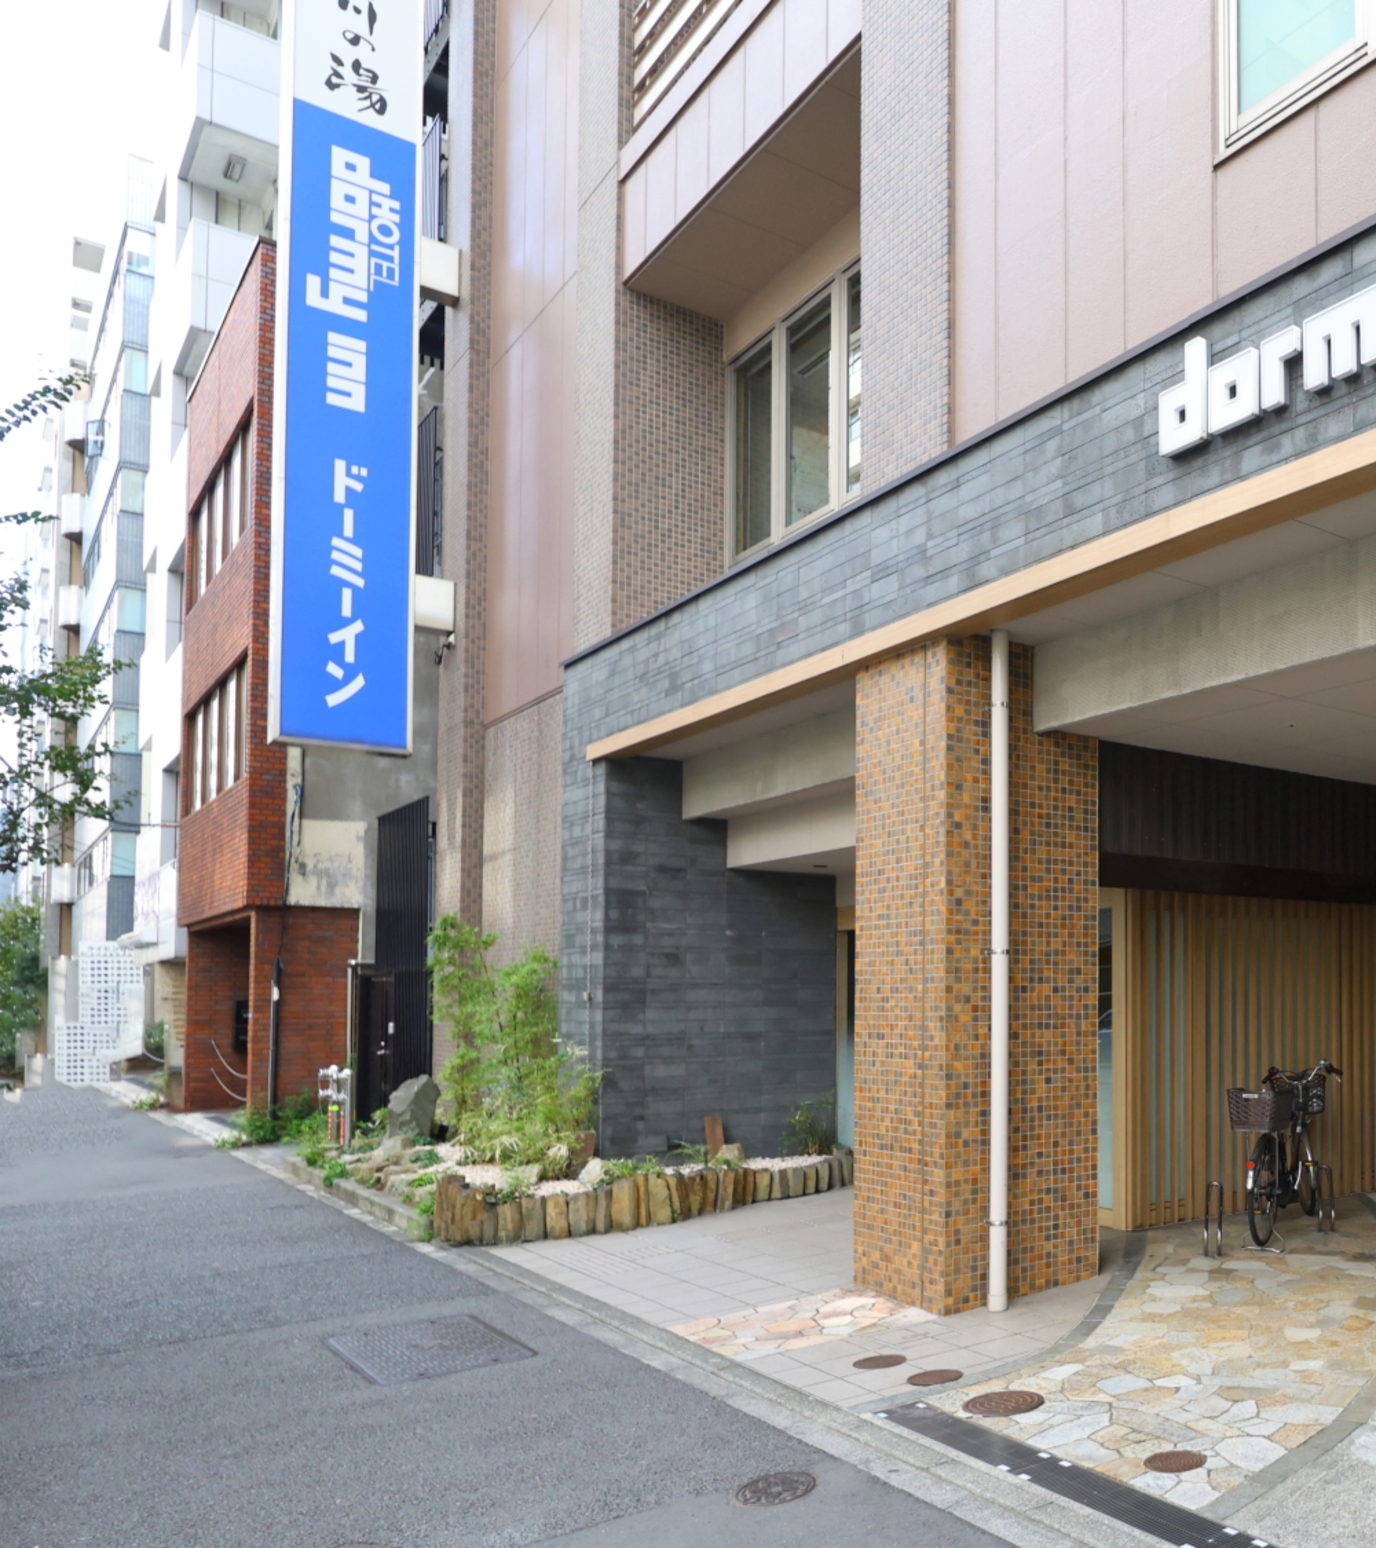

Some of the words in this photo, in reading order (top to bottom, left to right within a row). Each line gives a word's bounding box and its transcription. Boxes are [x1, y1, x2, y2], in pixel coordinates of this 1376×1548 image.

[305, 144, 391, 323] dormy
[369, 191, 401, 292] HOTEL
[325, 330, 367, 413] inn
[324, 457, 368, 708] ドーミーイン
